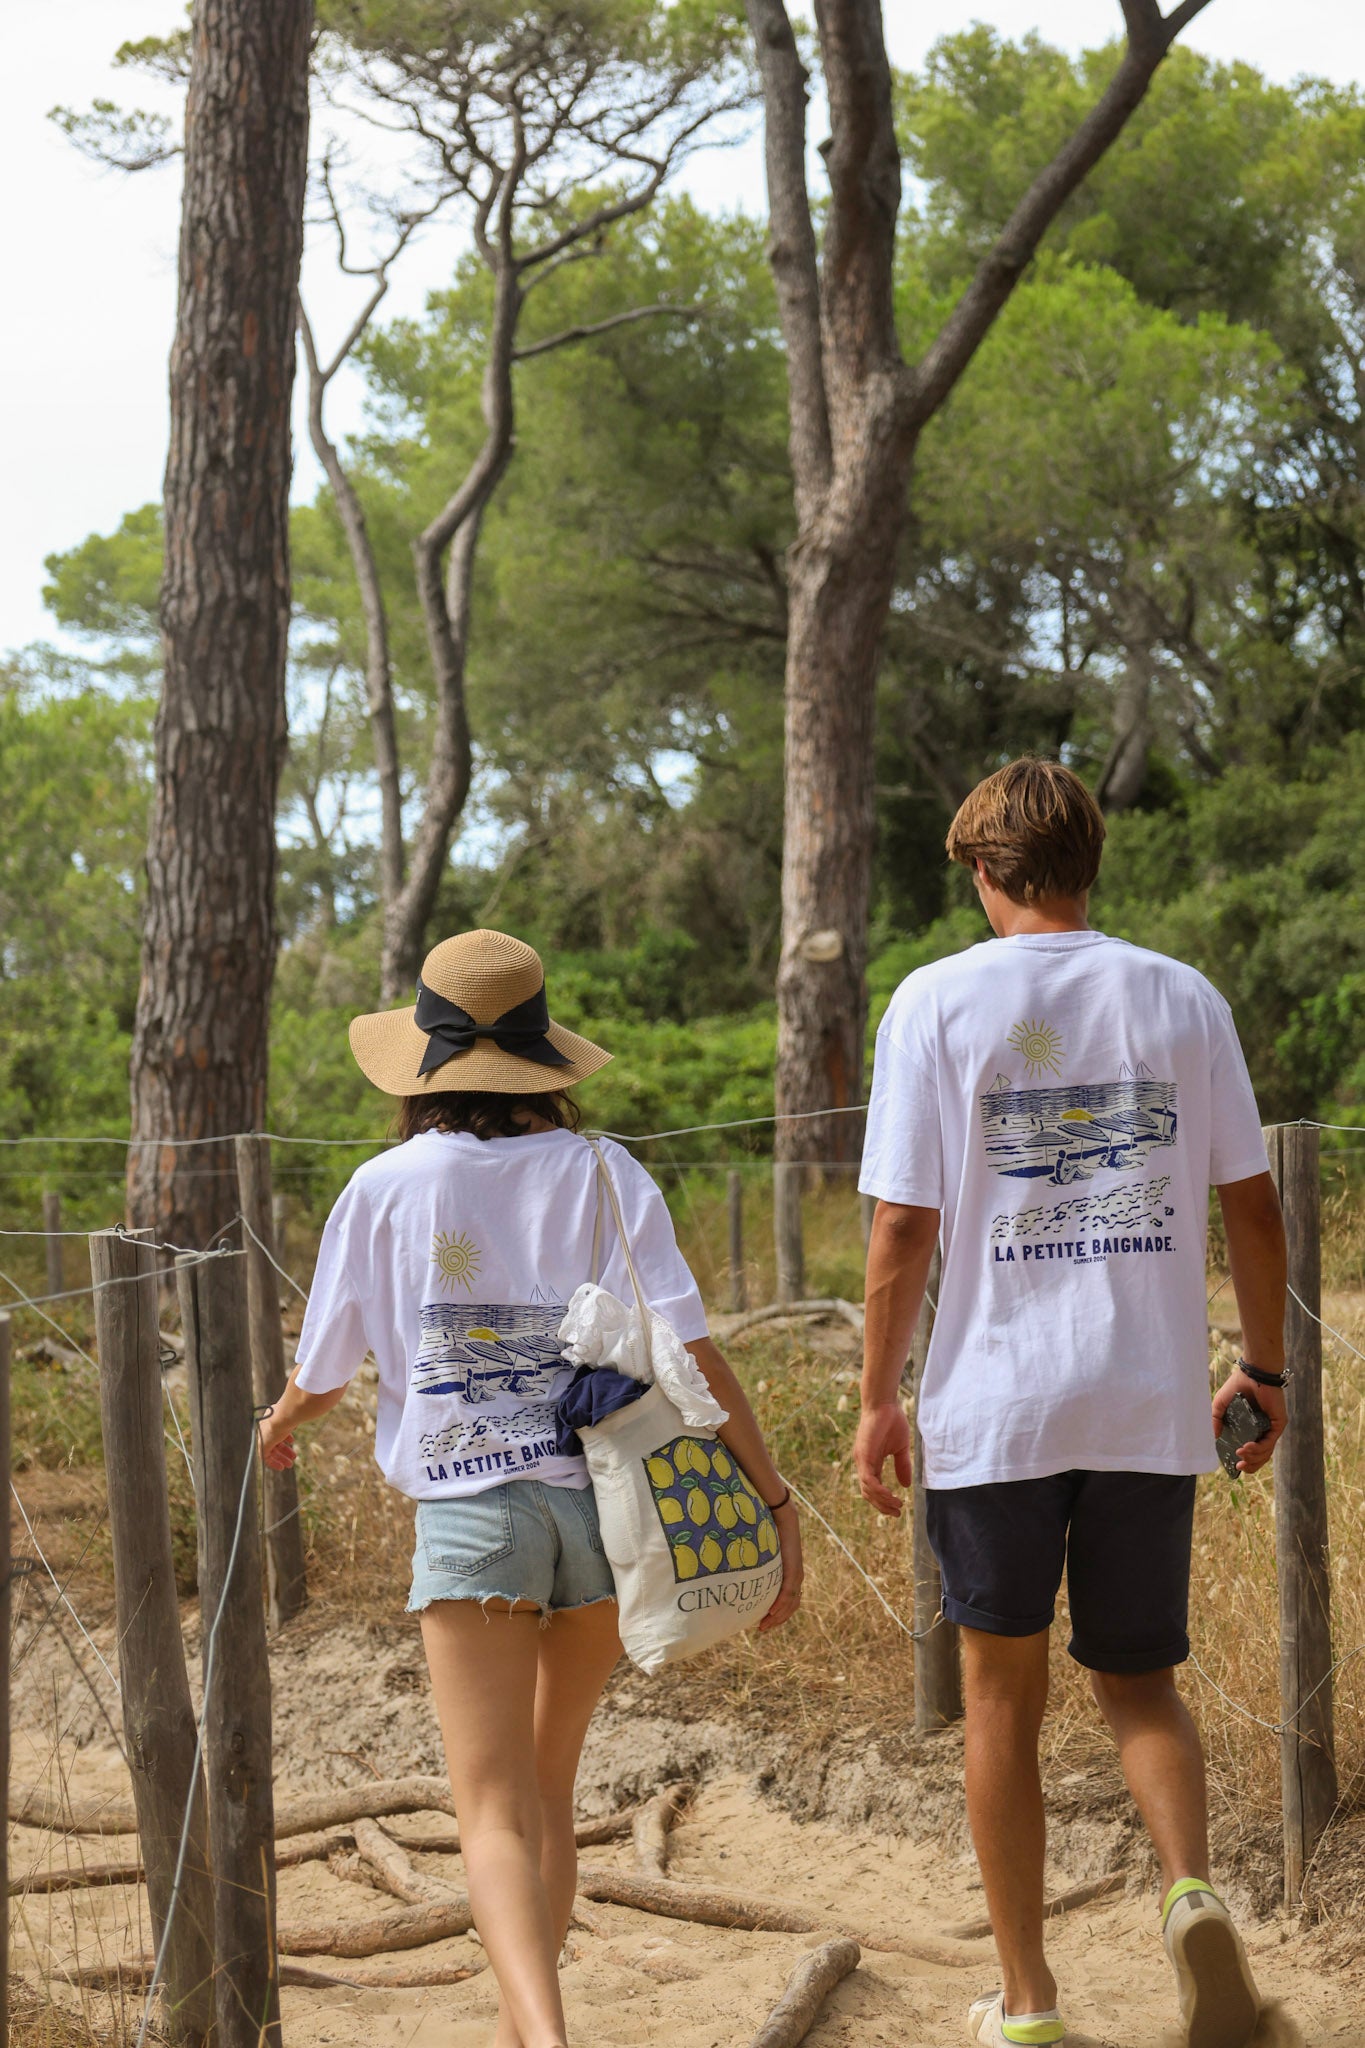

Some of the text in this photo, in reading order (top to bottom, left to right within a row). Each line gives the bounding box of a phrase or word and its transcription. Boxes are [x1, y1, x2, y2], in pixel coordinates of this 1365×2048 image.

[995, 1236, 1176, 1262] LA PETITE BAIGNADE.
[426, 1464, 448, 1482] LA
[453, 1450, 516, 1477] PETITE
[503, 1460, 540, 1475] SUMMER 2024
[677, 1576, 765, 1613] CINQUE
